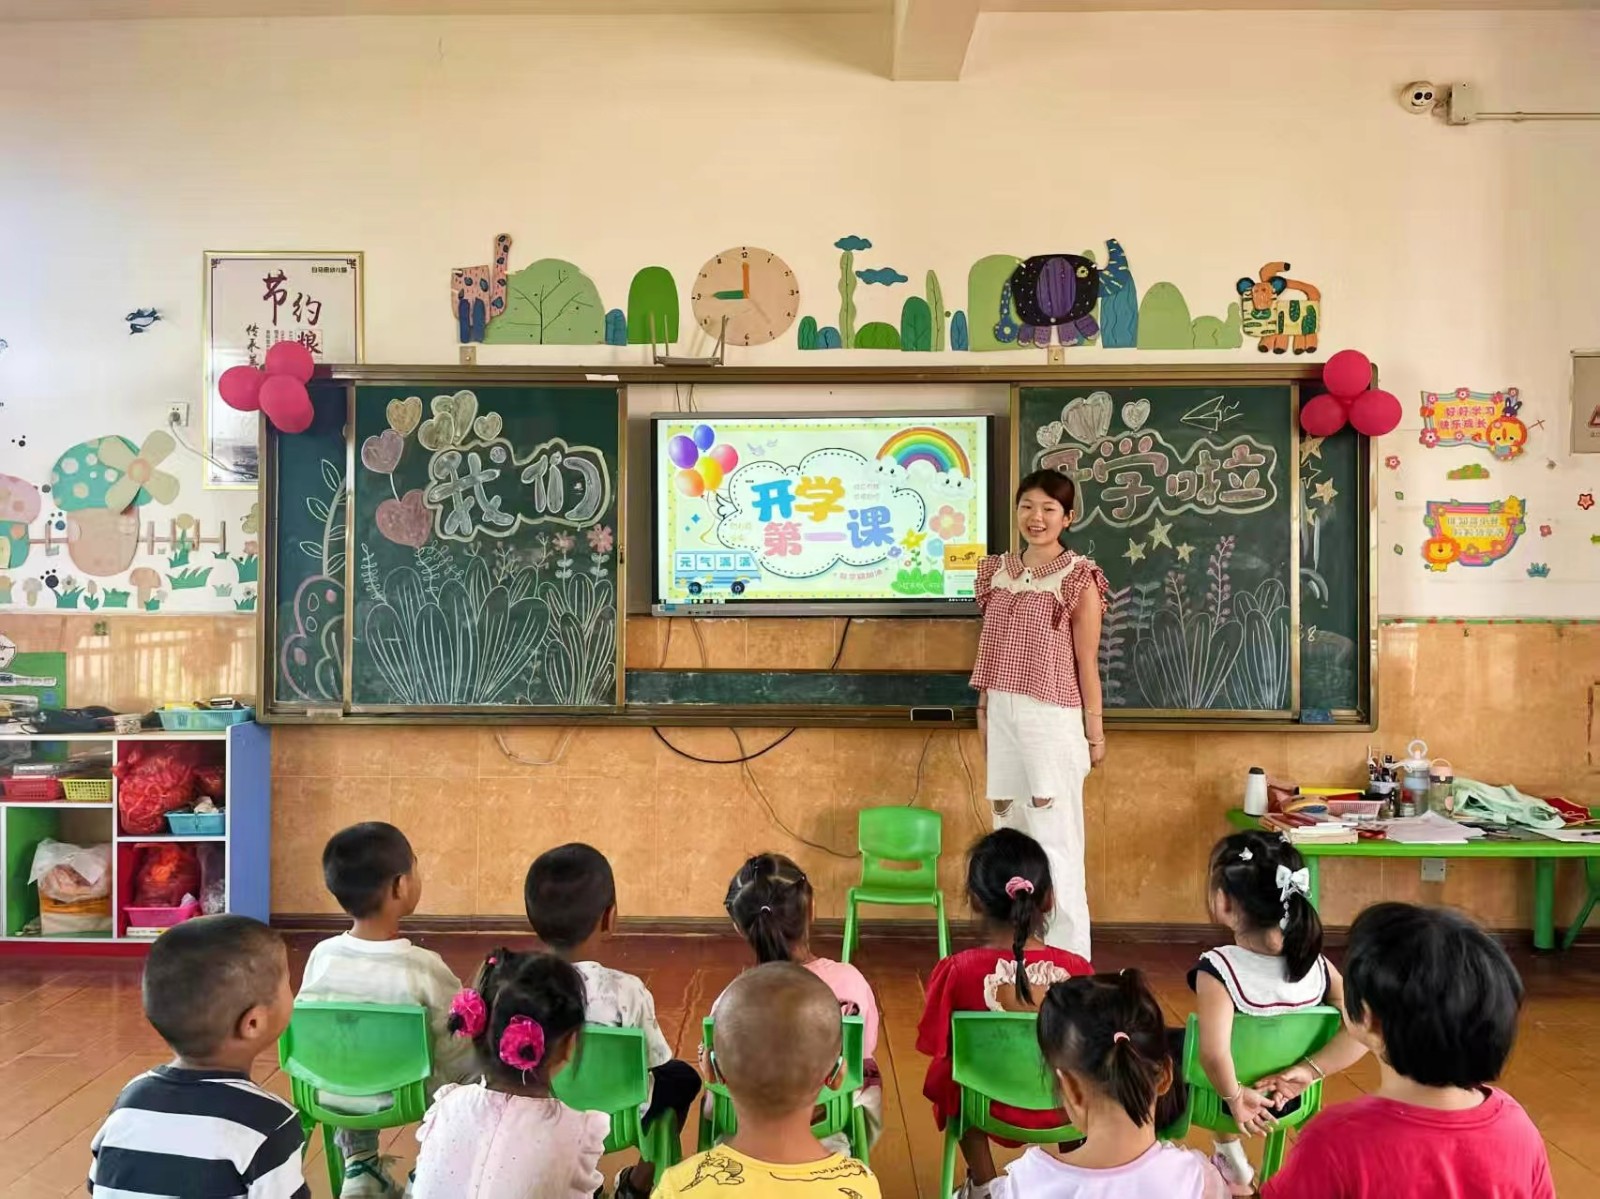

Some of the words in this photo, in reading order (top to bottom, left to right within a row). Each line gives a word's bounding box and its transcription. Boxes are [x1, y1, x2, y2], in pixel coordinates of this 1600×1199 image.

[262, 269, 322, 326] 节约
[1440, 418, 1486, 429] 快乐成长
[1446, 405, 1495, 417] 好好学习
[428, 445, 602, 536] 我们
[751, 476, 846, 522] 开学
[1040, 435, 1267, 523] 开学啦
[763, 505, 896, 557] 第一课
[680, 556, 752, 568] 元气满满
